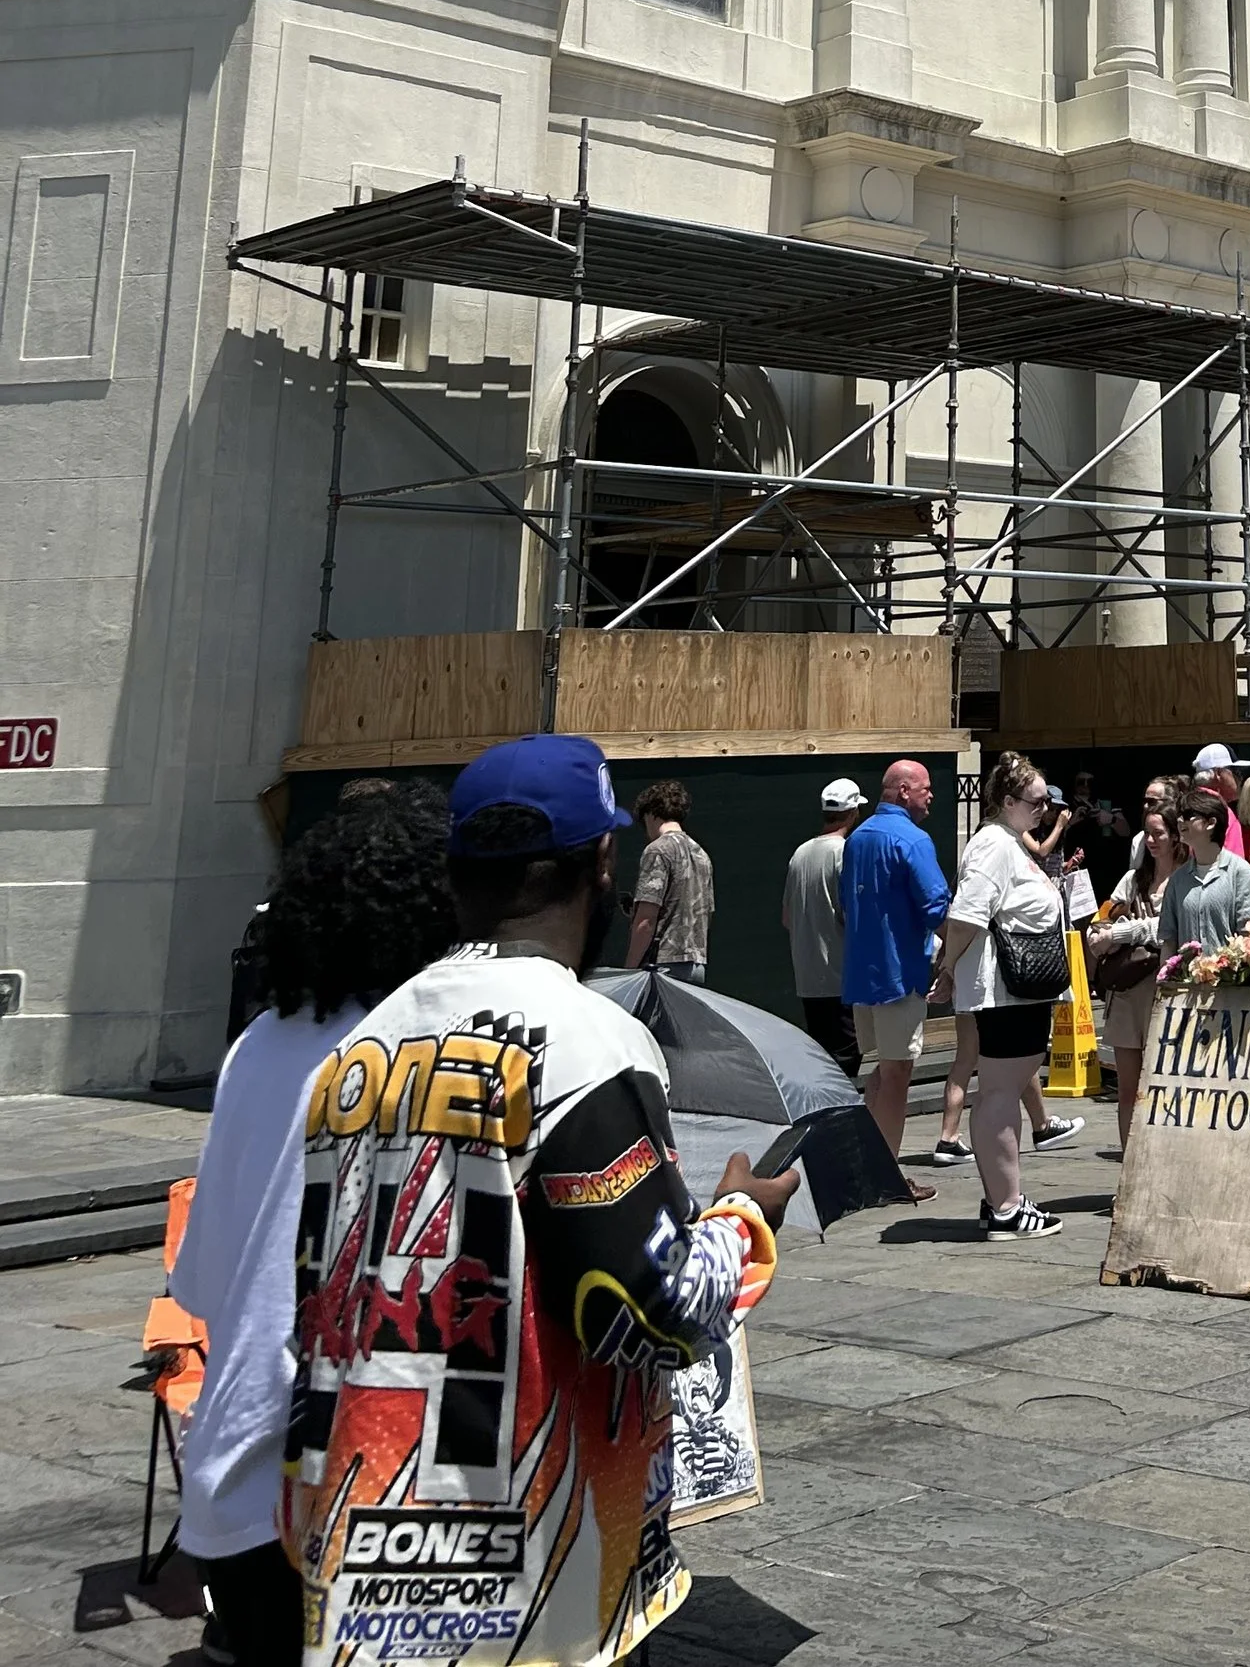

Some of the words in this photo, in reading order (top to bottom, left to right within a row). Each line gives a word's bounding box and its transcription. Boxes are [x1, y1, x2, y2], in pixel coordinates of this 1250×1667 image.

[344, 1521, 525, 1564] BONES
[348, 1577, 515, 1606] MOTOSPORT
[335, 1609, 521, 1642] MOTOCROSS
[386, 1643, 464, 1657] ACTION
